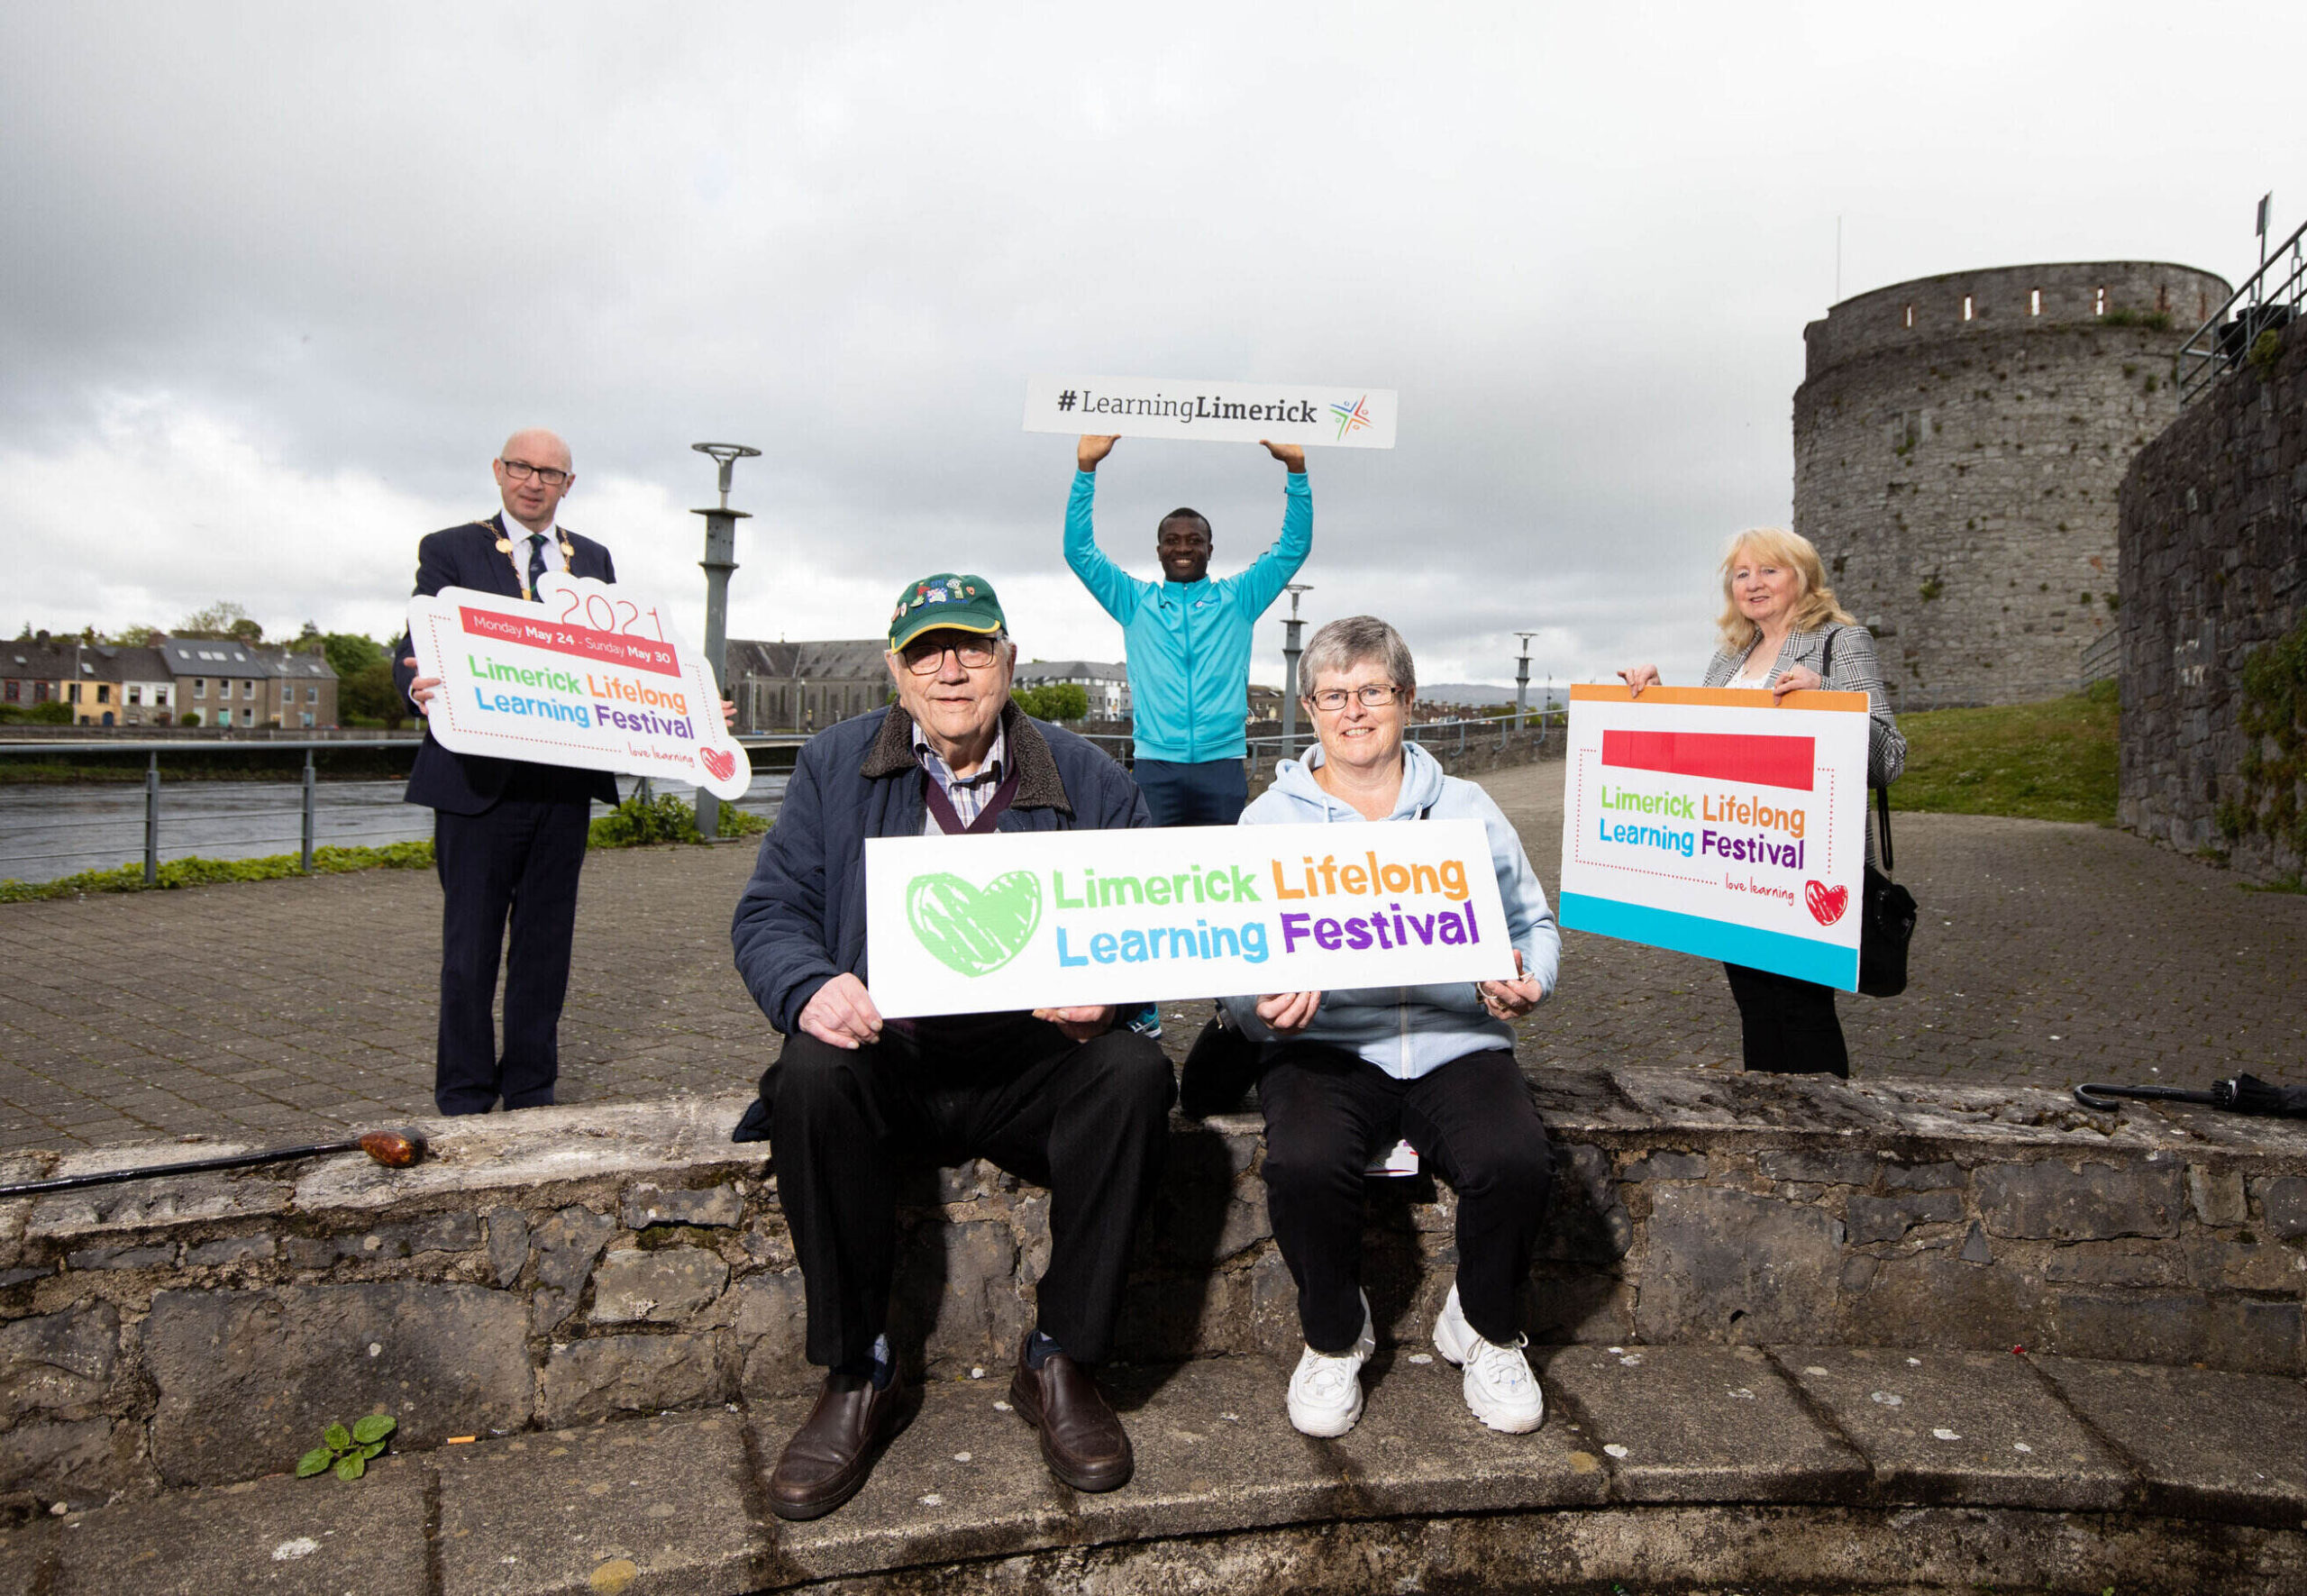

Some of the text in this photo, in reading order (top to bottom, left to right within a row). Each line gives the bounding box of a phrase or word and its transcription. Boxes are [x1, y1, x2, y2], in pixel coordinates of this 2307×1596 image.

[473, 616, 523, 639] Monday
[525, 625, 552, 645] May
[556, 632, 575, 647] 24
[585, 638, 625, 659] Sunday
[627, 645, 653, 664] May
[655, 651, 671, 664] 30
[556, 588, 664, 643] 2021
[468, 654, 688, 716] Limerick Lifelong
[475, 687, 695, 740] Learning Festival
[628, 742, 695, 768] love learning
[1601, 785, 1805, 838] Limerick Lifelong
[1600, 818, 1804, 870] Learning Festival
[1054, 851, 1470, 909] Limerick Lifelong
[1726, 873, 1794, 907] love learning
[1056, 901, 1481, 967] Learning Festival
